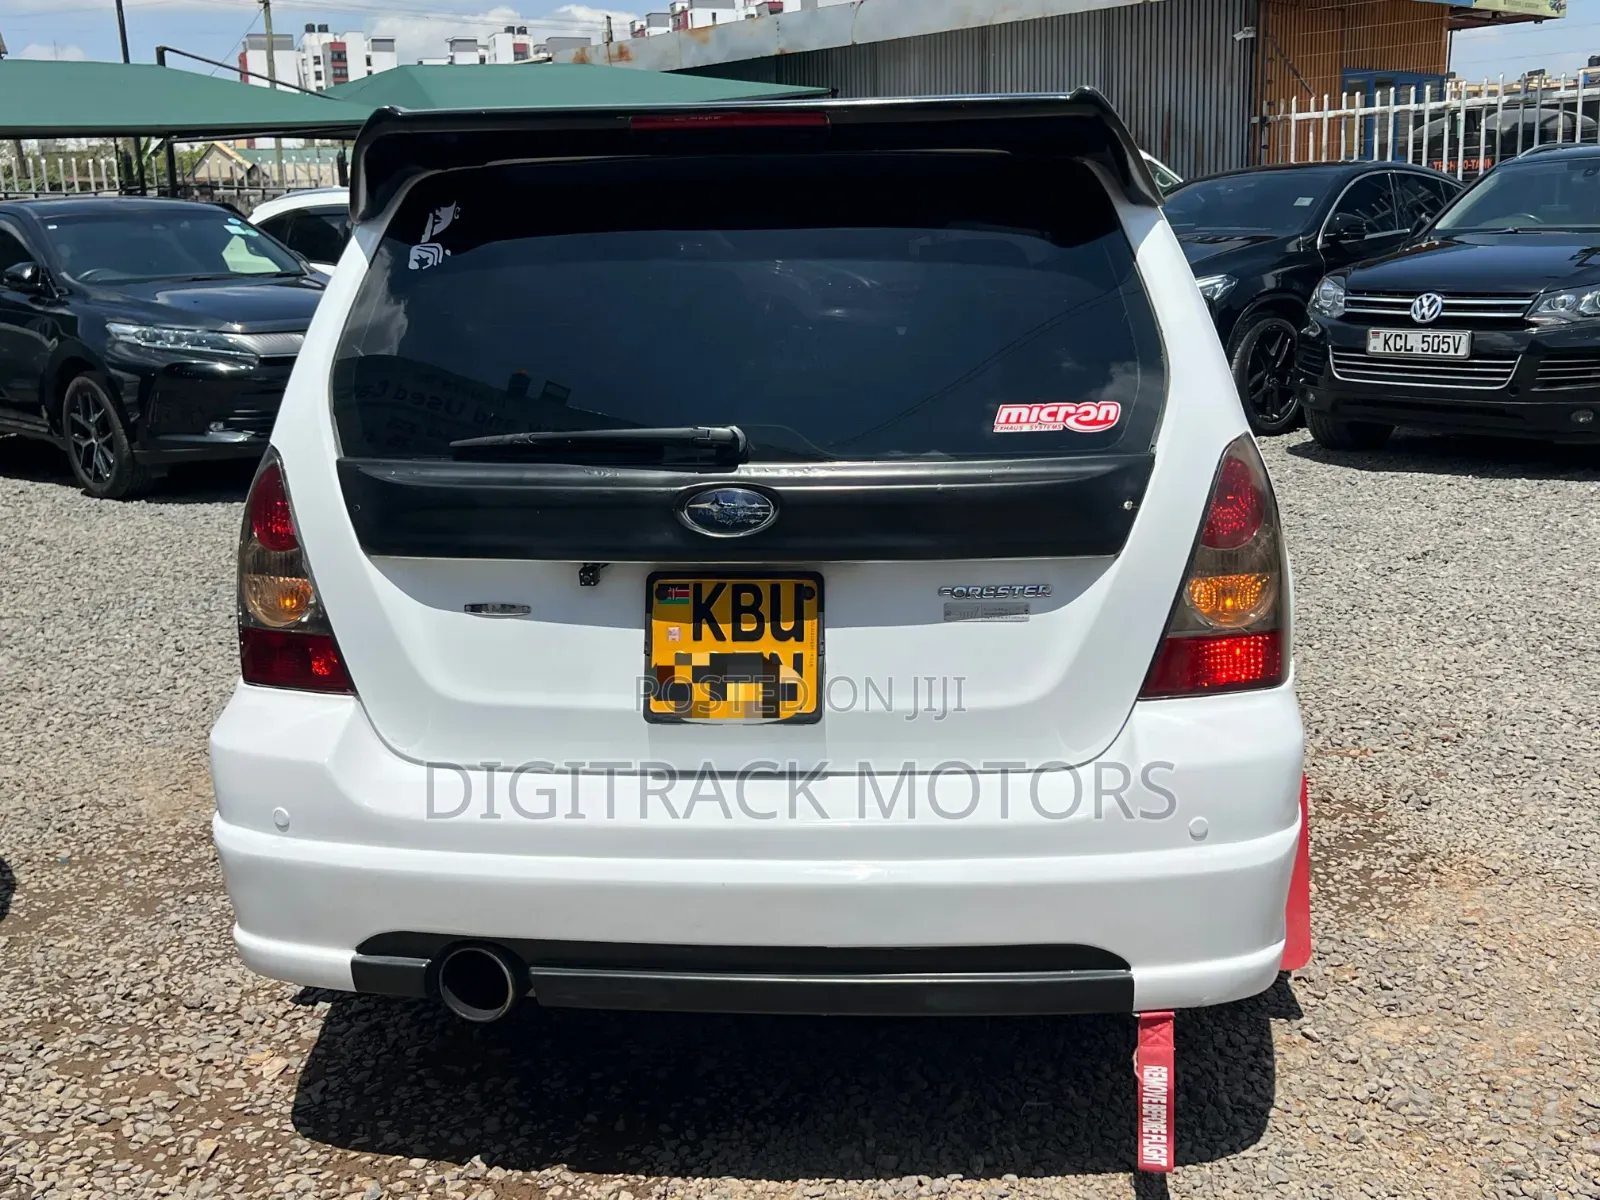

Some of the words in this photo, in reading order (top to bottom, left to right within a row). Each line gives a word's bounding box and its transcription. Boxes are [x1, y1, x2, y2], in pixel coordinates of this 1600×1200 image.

[1383, 333, 1414, 352] KCL
[1421, 334, 1462, 354] 505V
[999, 402, 1119, 431] micron
[938, 584, 1052, 600] FORESTER
[692, 582, 804, 642] KBU
[1143, 1065, 1168, 1104] REMOVE
[1143, 1104, 1167, 1134] BEFORE
[1143, 1134, 1168, 1167] FLIGHT
